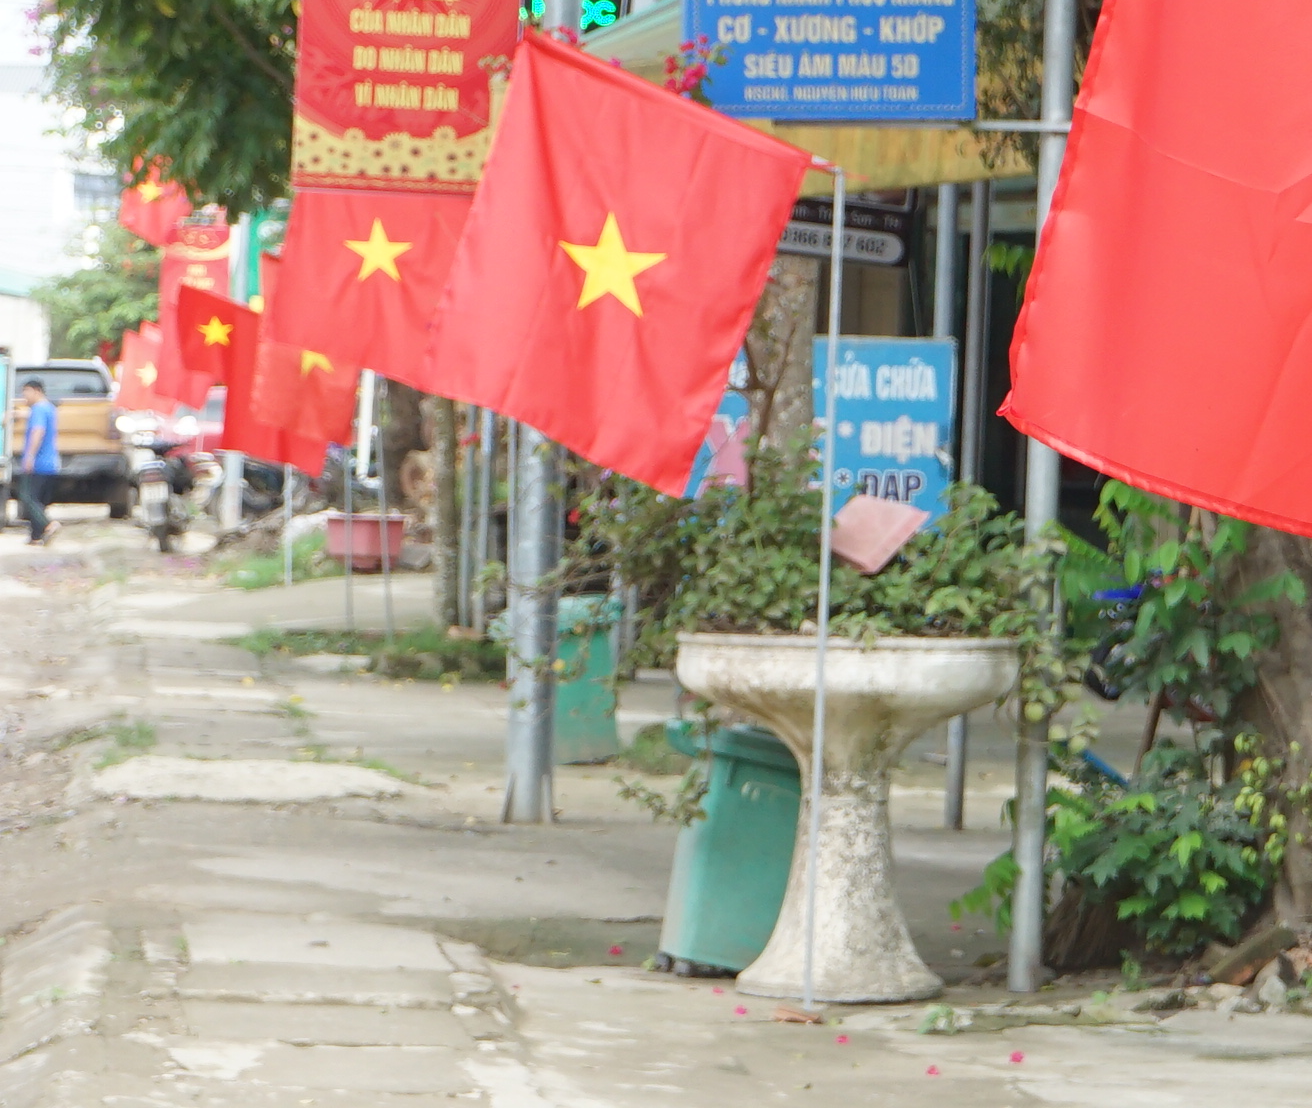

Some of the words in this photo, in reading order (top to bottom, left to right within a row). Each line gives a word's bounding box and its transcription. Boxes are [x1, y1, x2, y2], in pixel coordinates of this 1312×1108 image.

[349, 1, 385, 34] CỦA
[385, 6, 434, 37] NHÂN
[434, 9, 471, 40] DÂN
[717, 13, 753, 44] CƠ
[773, 13, 858, 44] XƯƠNG
[879, 10, 946, 44] KHỚP
[378, 43, 427, 74] NHÂN
[427, 45, 464, 76] DÂN
[744, 49, 794, 79] SIÊU
[797, 48, 834, 79] ÂM
[838, 49, 888, 79] MÀU
[373, 79, 422, 111] NHÂN
[422, 81, 460, 113] DÂN
[876, 357, 938, 402] CHỮA
[860, 415, 939, 465] ĐIỆN
